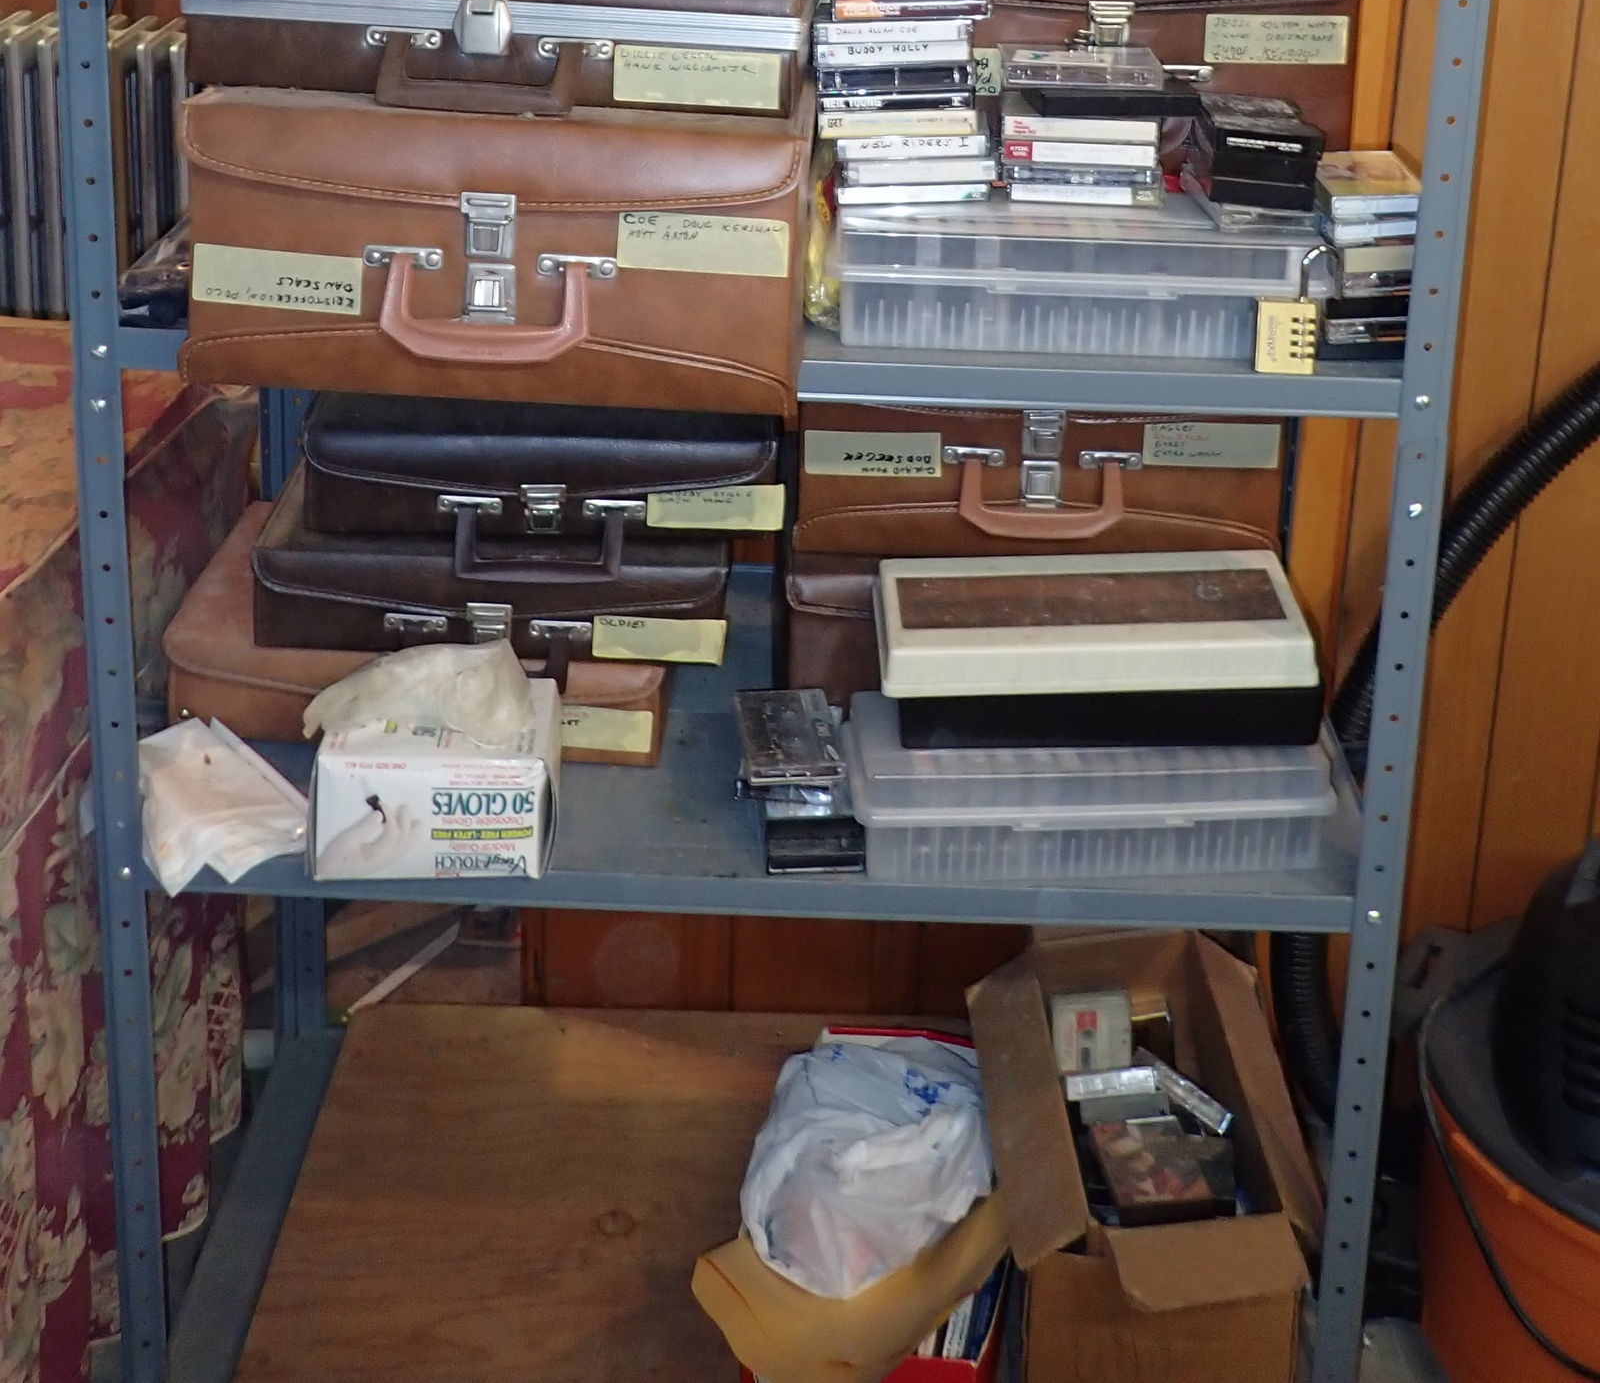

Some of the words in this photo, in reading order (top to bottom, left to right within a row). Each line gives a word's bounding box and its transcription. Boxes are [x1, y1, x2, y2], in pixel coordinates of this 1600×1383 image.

[847, 45, 882, 55] BUDDY
[892, 43, 929, 52] HOLLY
[901, 138, 951, 148] RIDERS
[324, 281, 353, 293] DAN
[598, 617, 647, 629] OLDIES
[431, 792, 508, 816] GLOVES
[512, 791, 536, 815] 50
